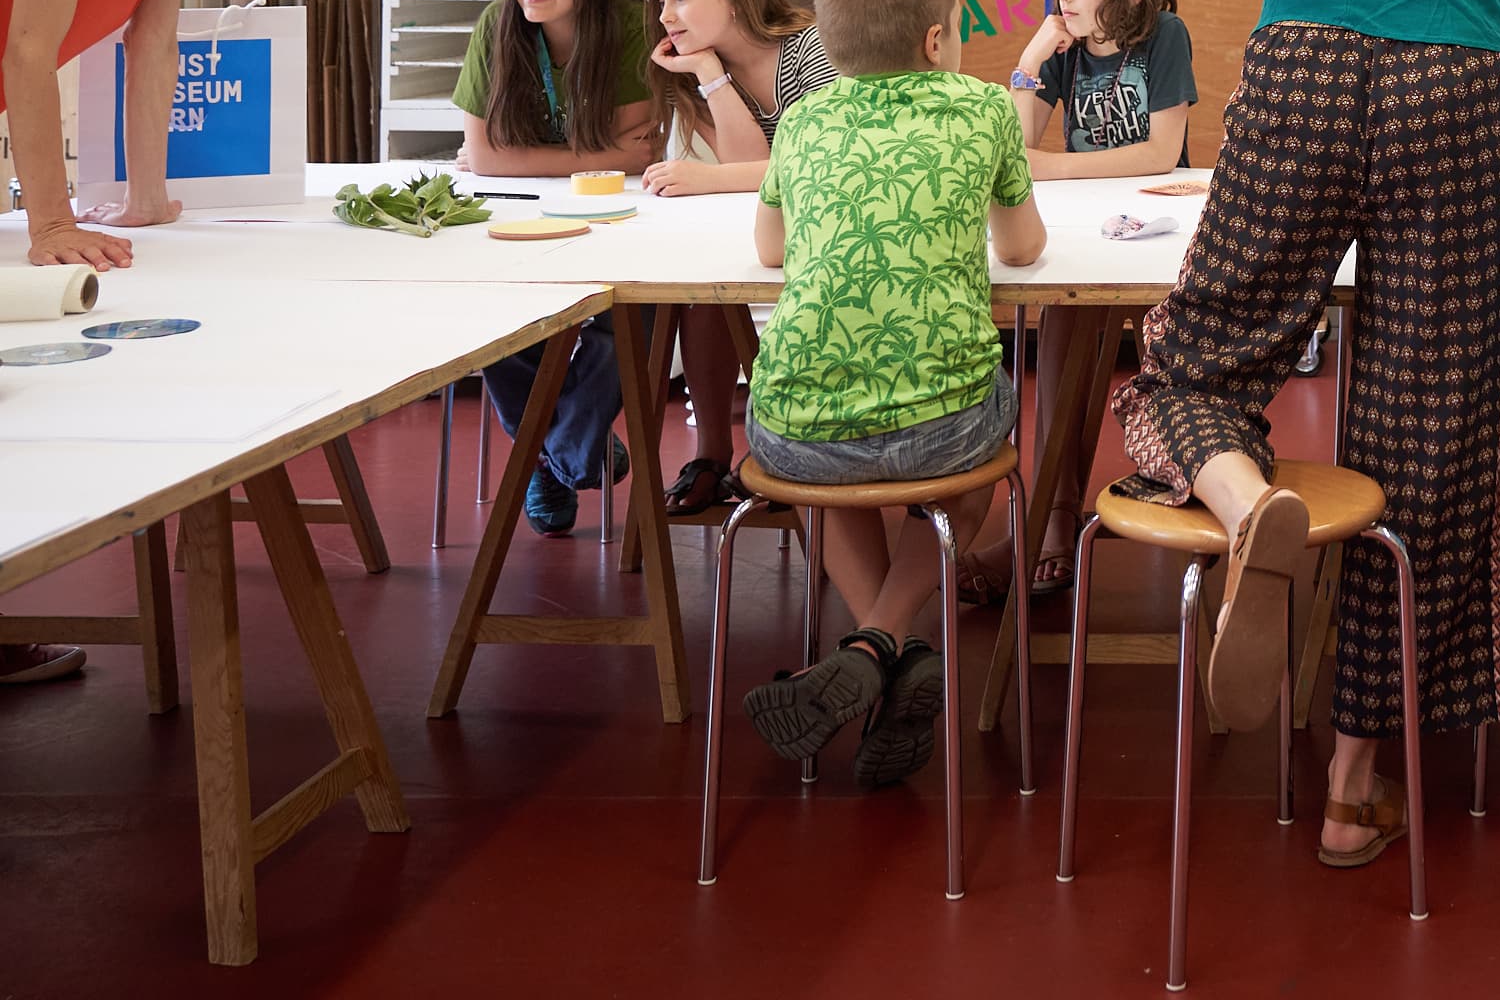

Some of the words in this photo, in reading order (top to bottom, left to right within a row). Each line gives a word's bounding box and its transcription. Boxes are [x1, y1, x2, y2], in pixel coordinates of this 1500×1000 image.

[173, 79, 242, 103] SEUM
[1092, 85, 1114, 105] BE
[1075, 85, 1141, 128] KIND
[168, 108, 205, 133] RN
